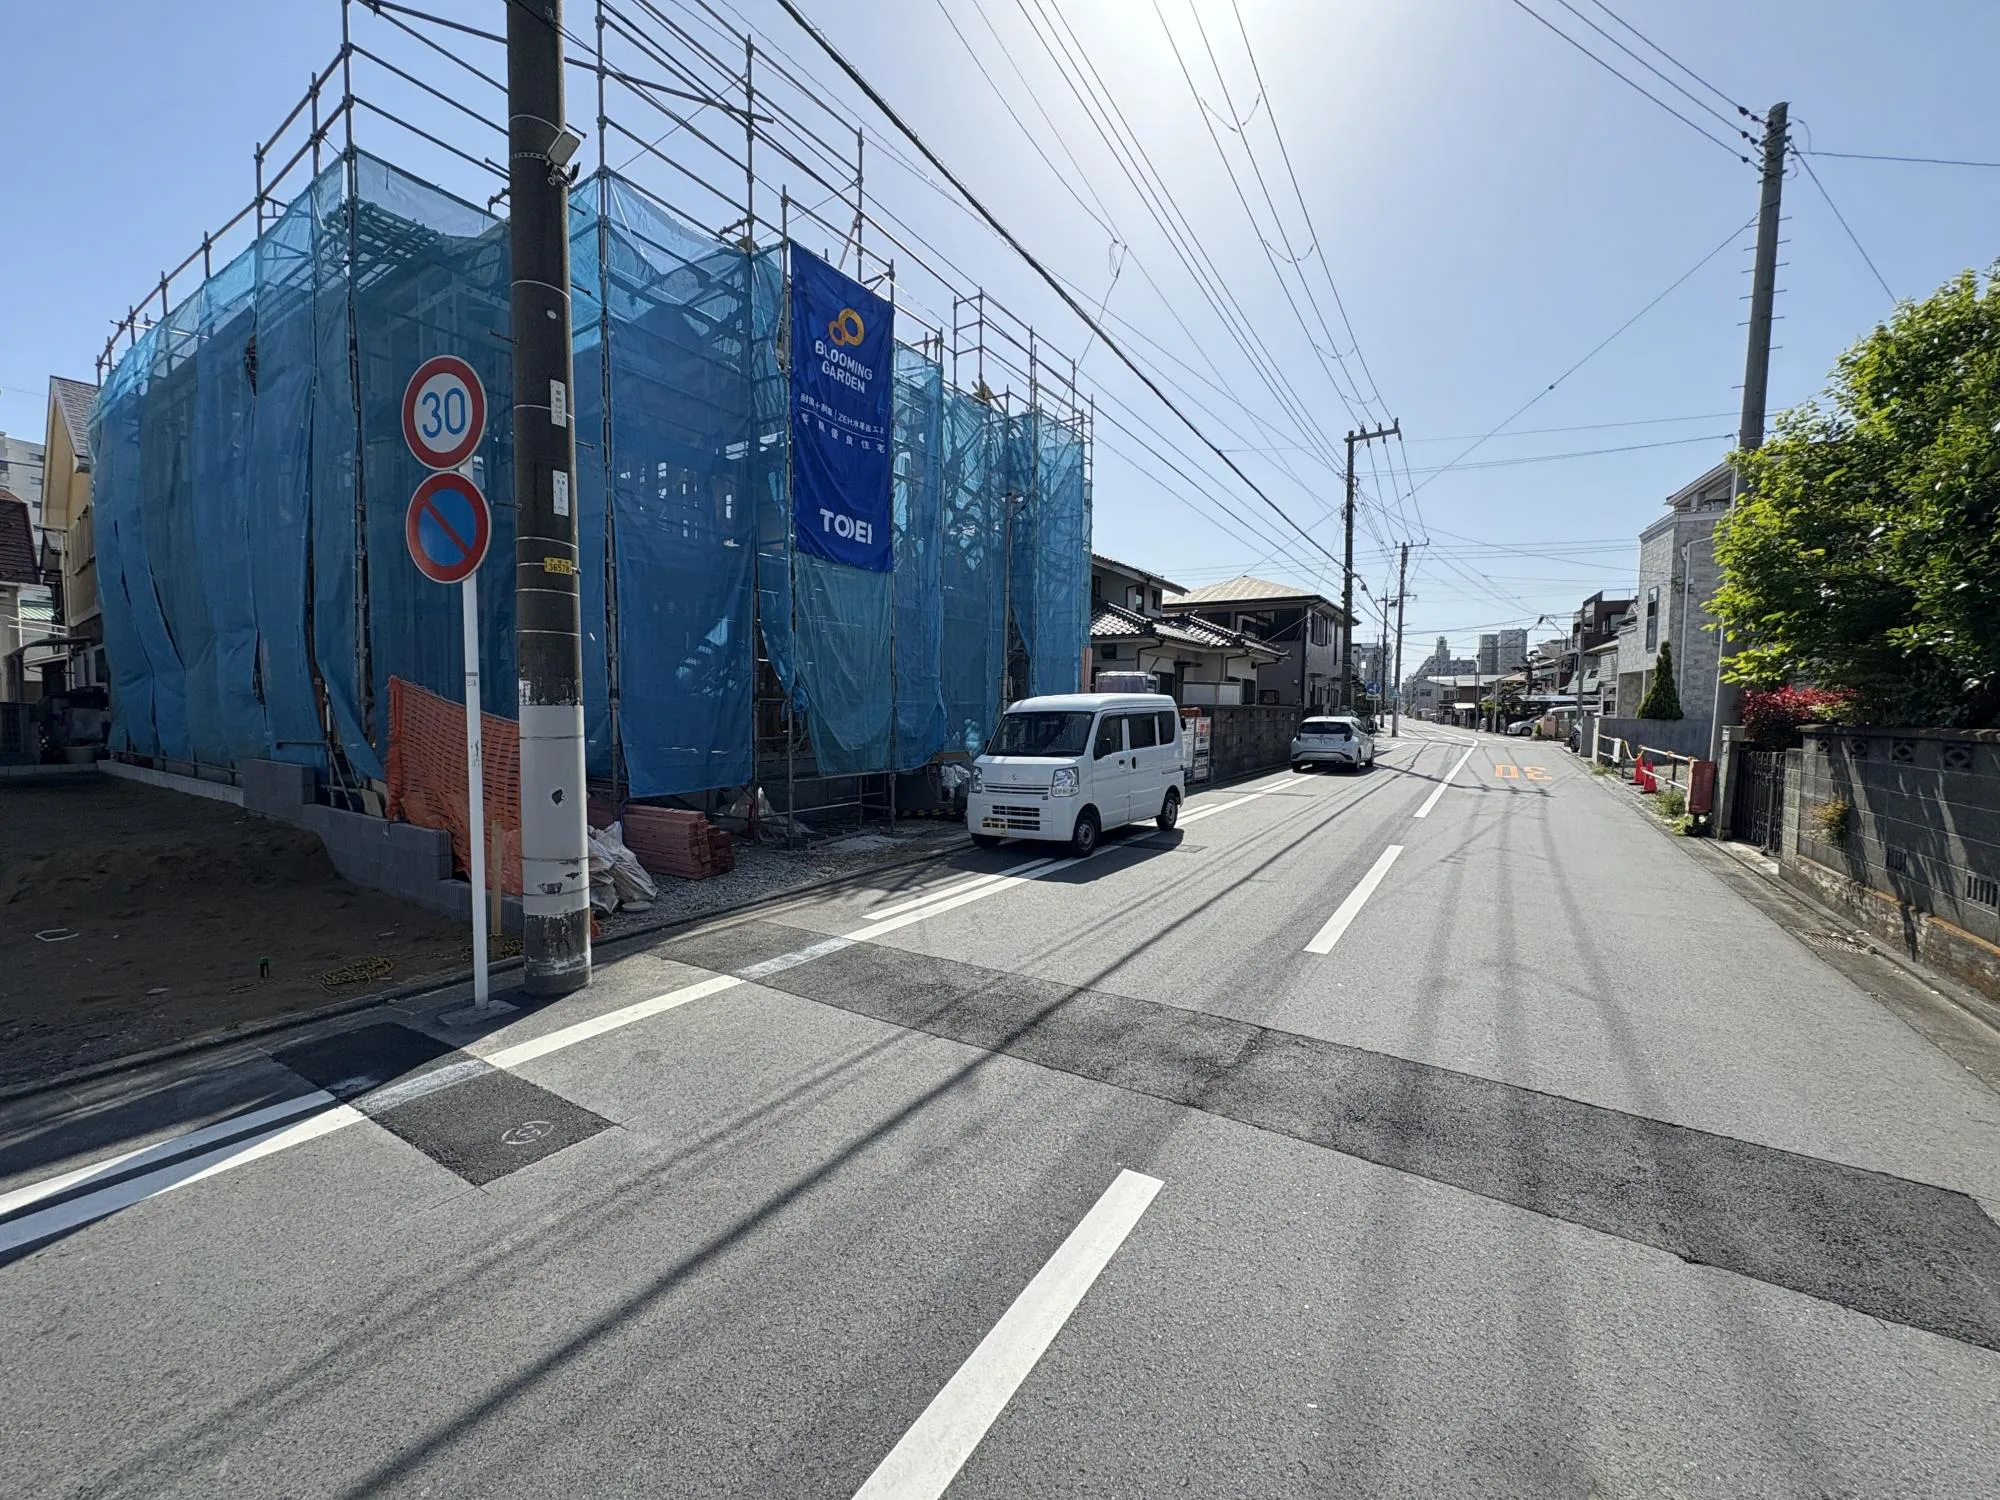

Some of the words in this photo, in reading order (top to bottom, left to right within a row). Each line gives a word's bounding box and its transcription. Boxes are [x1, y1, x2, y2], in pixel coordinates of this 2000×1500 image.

[815, 339, 873, 380] BLOOMING
[821, 360, 866, 394] GARDEN
[422, 387, 466, 438] 30
[819, 507, 873, 545] TOEI
[1495, 764, 1553, 781] 30
